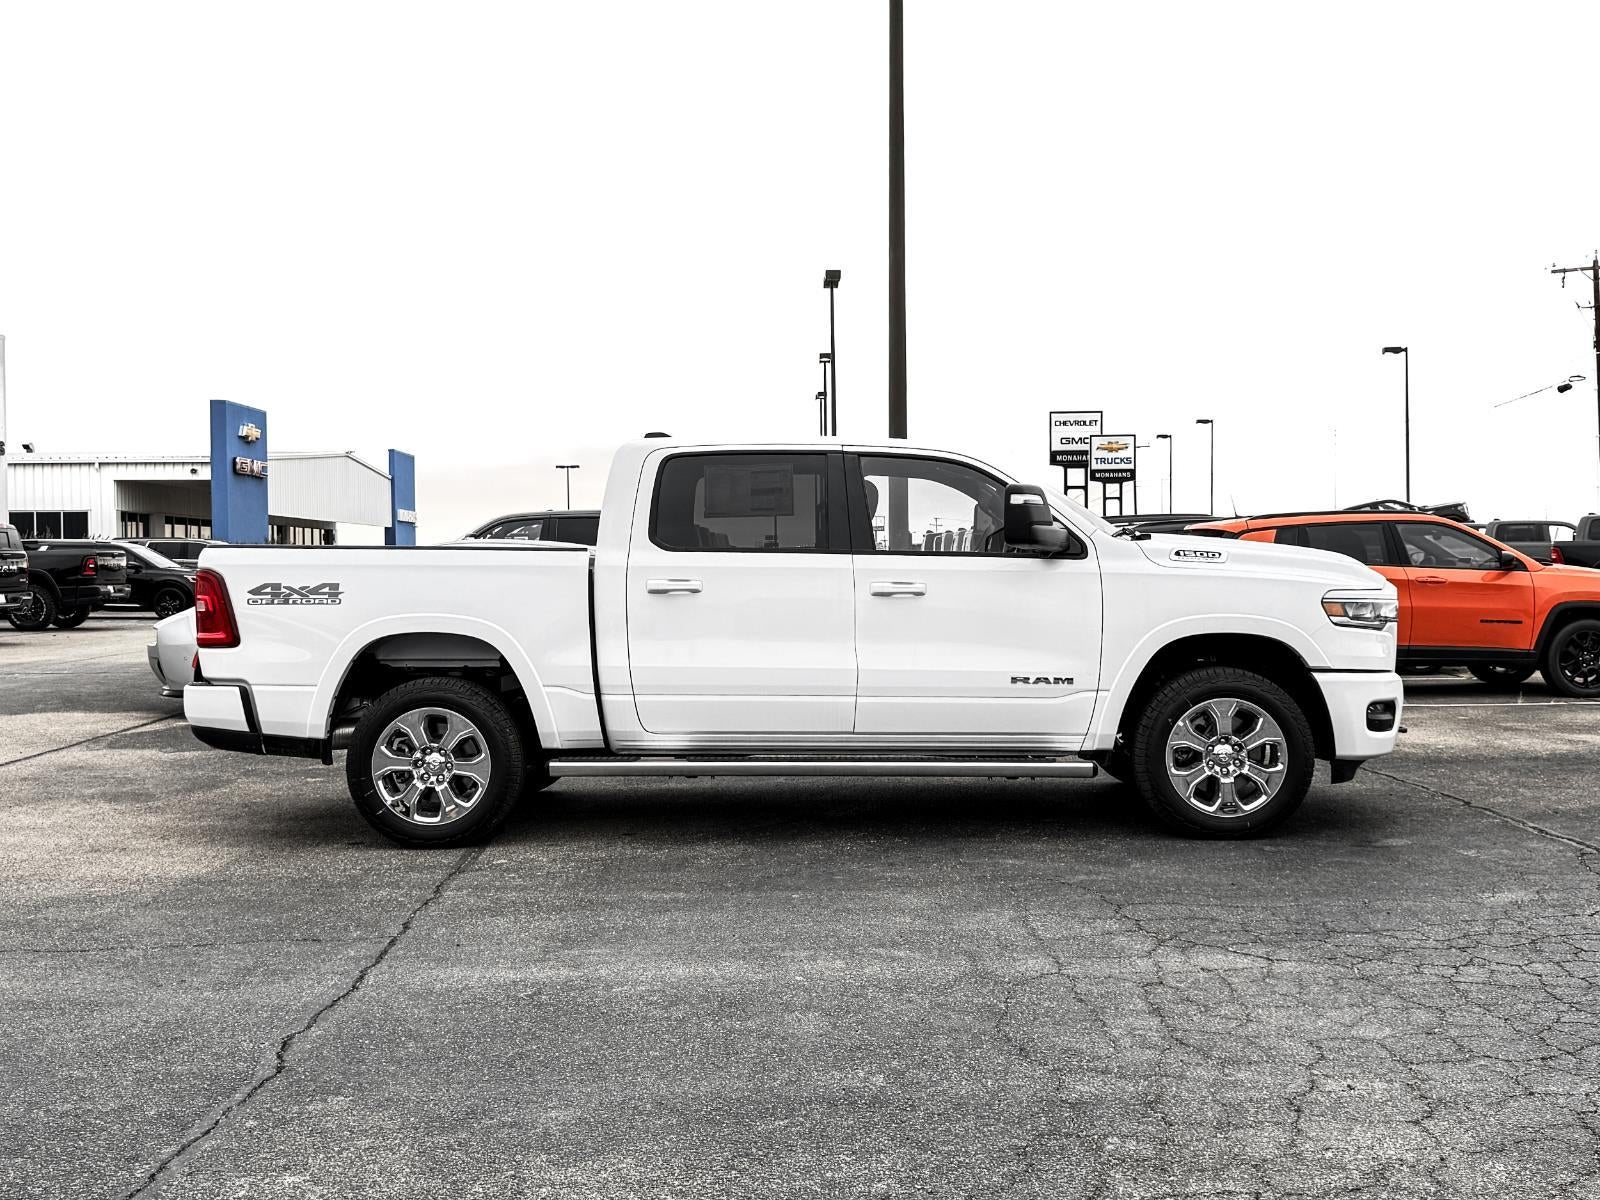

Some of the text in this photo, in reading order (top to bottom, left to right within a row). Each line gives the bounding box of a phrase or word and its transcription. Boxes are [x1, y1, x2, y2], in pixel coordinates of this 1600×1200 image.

[1054, 419, 1098, 427] CHEVROLET
[1060, 437, 1089, 445] GMC
[1094, 457, 1132, 465] TRUCKS
[234, 456, 268, 478] GMC
[1174, 549, 1222, 558] 1500
[1010, 676, 1074, 685] RAM
